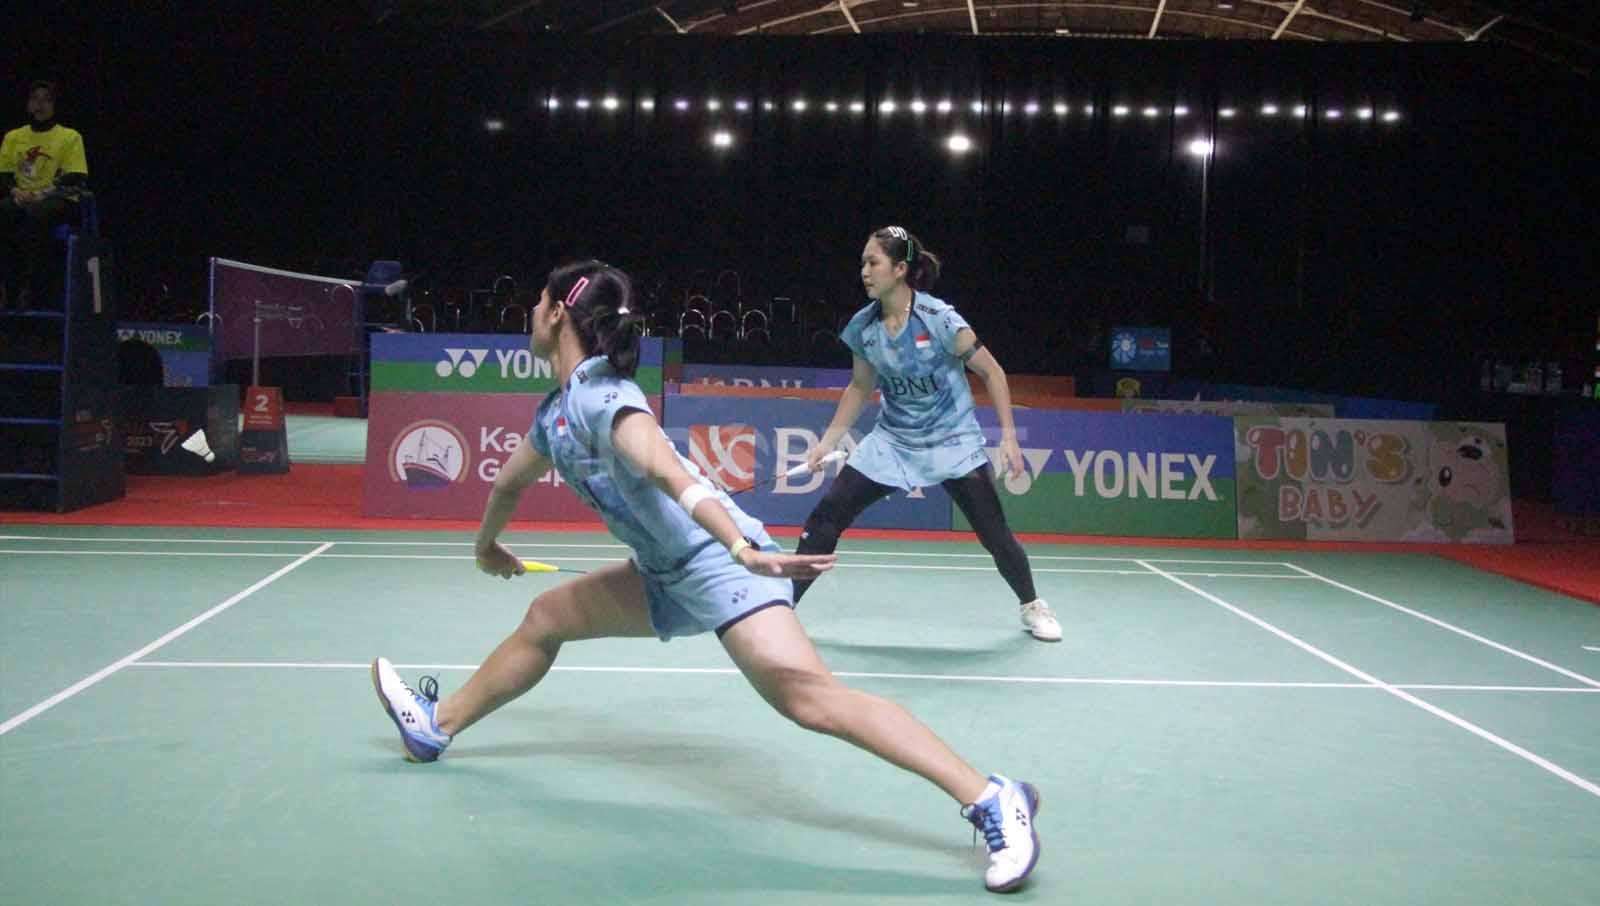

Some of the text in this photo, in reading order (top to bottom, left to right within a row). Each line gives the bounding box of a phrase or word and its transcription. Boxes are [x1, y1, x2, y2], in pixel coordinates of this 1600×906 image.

[87, 256, 102, 313] 1
[138, 329, 182, 345] YONEX
[495, 349, 553, 379] YON
[890, 373, 939, 396] BNI
[253, 394, 269, 412] 2
[1247, 424, 1409, 482] TIN'S
[1063, 449, 1217, 501] YONEX
[1278, 485, 1378, 523] BABY
